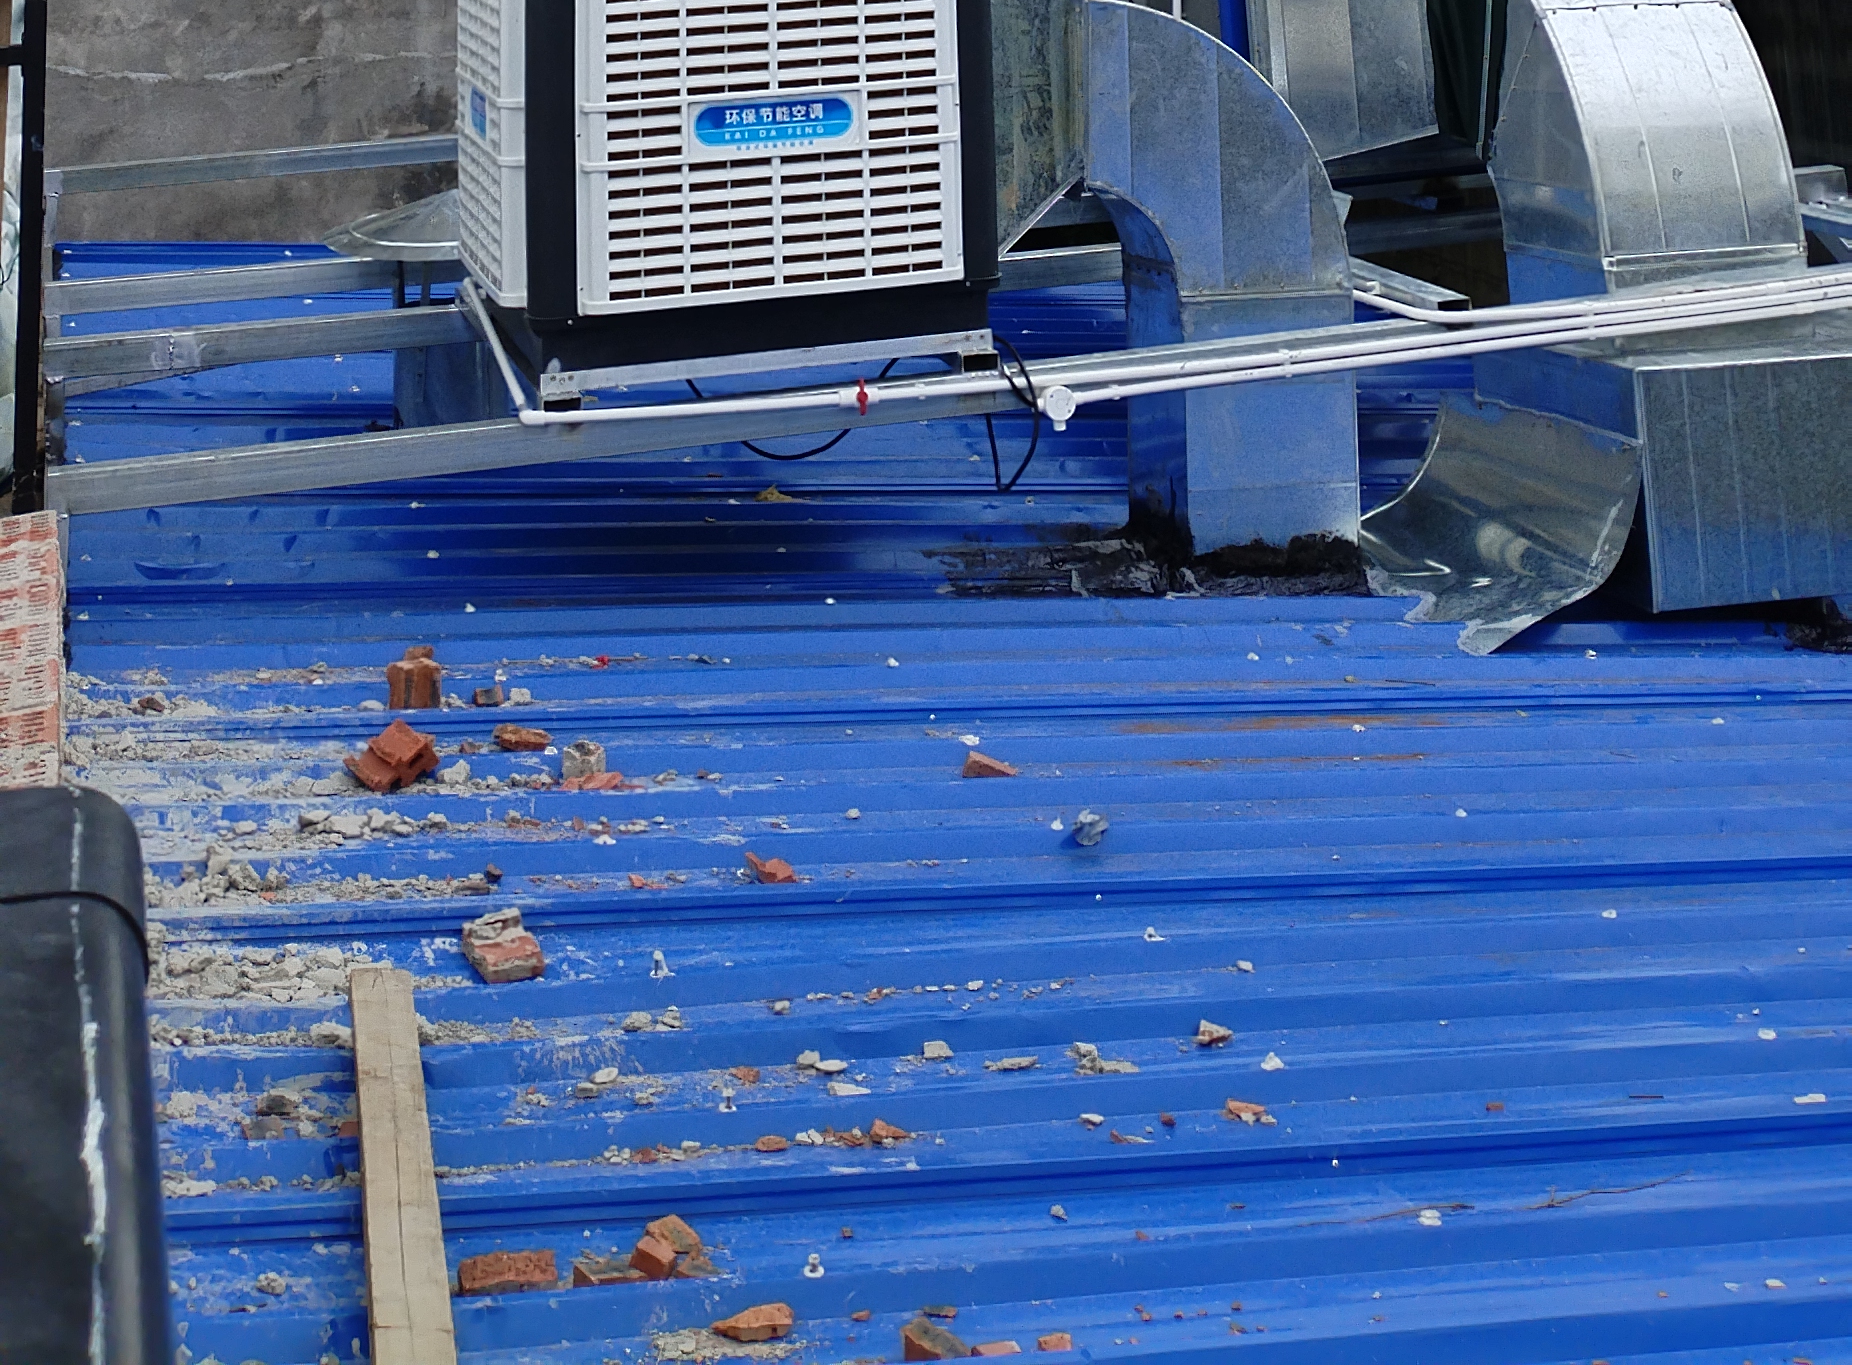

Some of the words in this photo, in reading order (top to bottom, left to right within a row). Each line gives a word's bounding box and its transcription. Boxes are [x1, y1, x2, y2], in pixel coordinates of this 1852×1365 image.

[724, 103, 824, 126] 环保节能空调
[759, 129, 777, 138] DA
